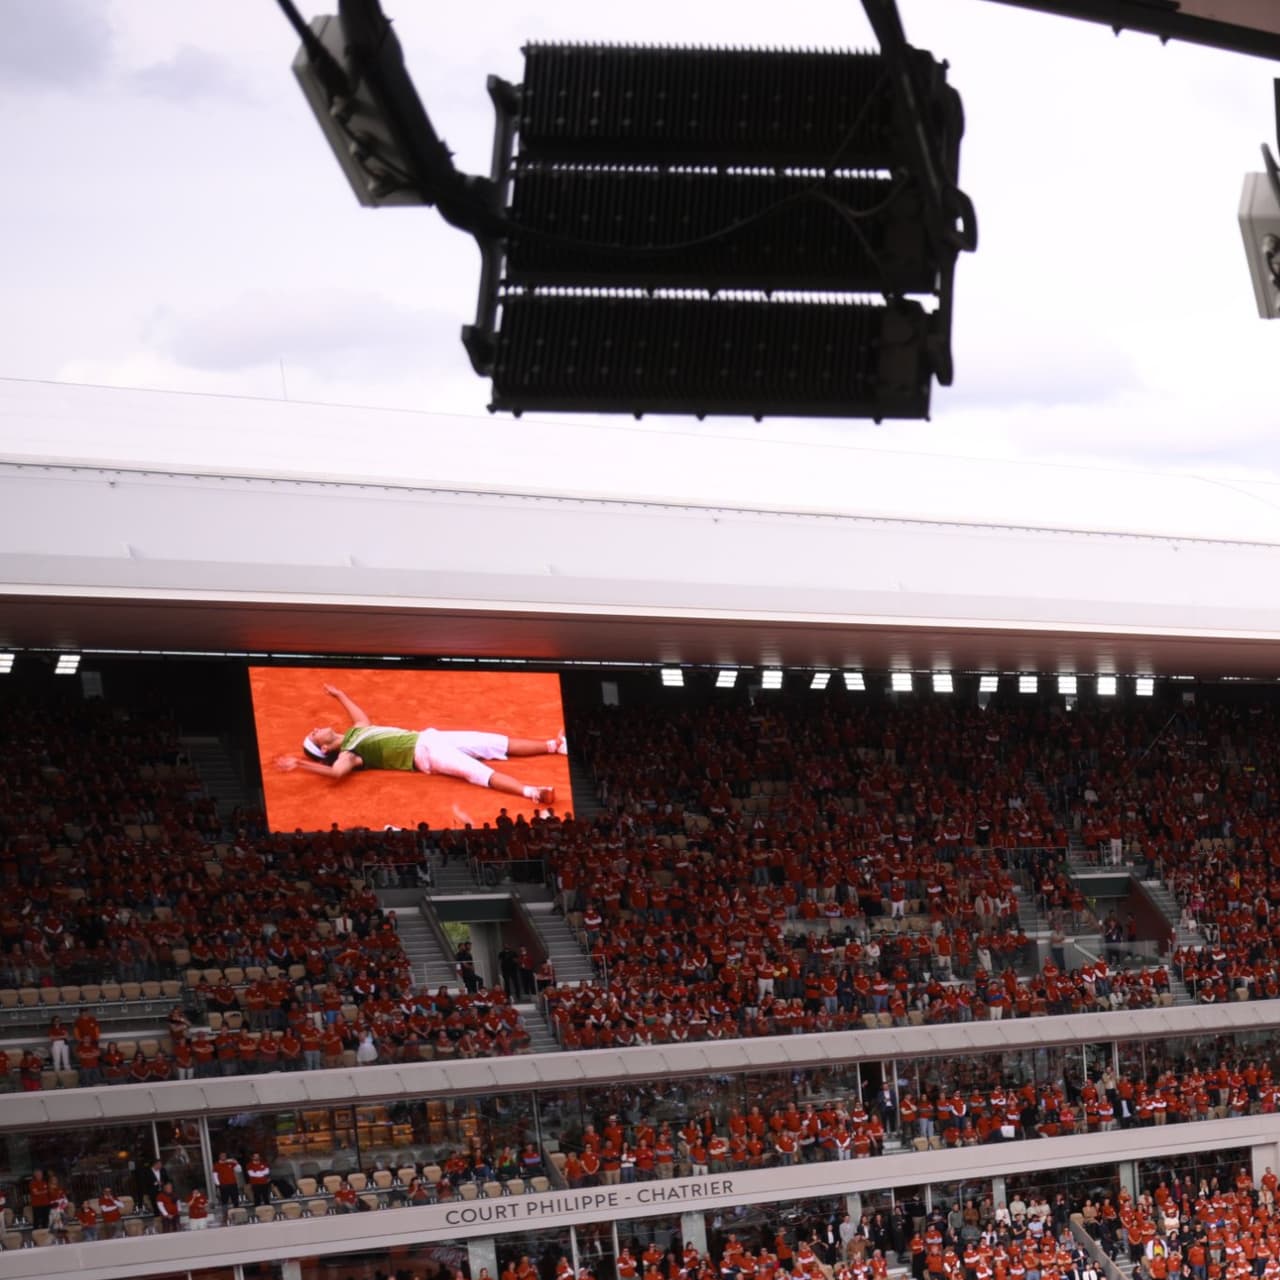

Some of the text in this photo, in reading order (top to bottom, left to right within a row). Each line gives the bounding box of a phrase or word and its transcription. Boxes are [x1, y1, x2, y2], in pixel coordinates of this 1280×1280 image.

[445, 1202, 520, 1225] COURT
[526, 1192, 619, 1216] PHILIPPE
[637, 1180, 734, 1203] CHATRIER
